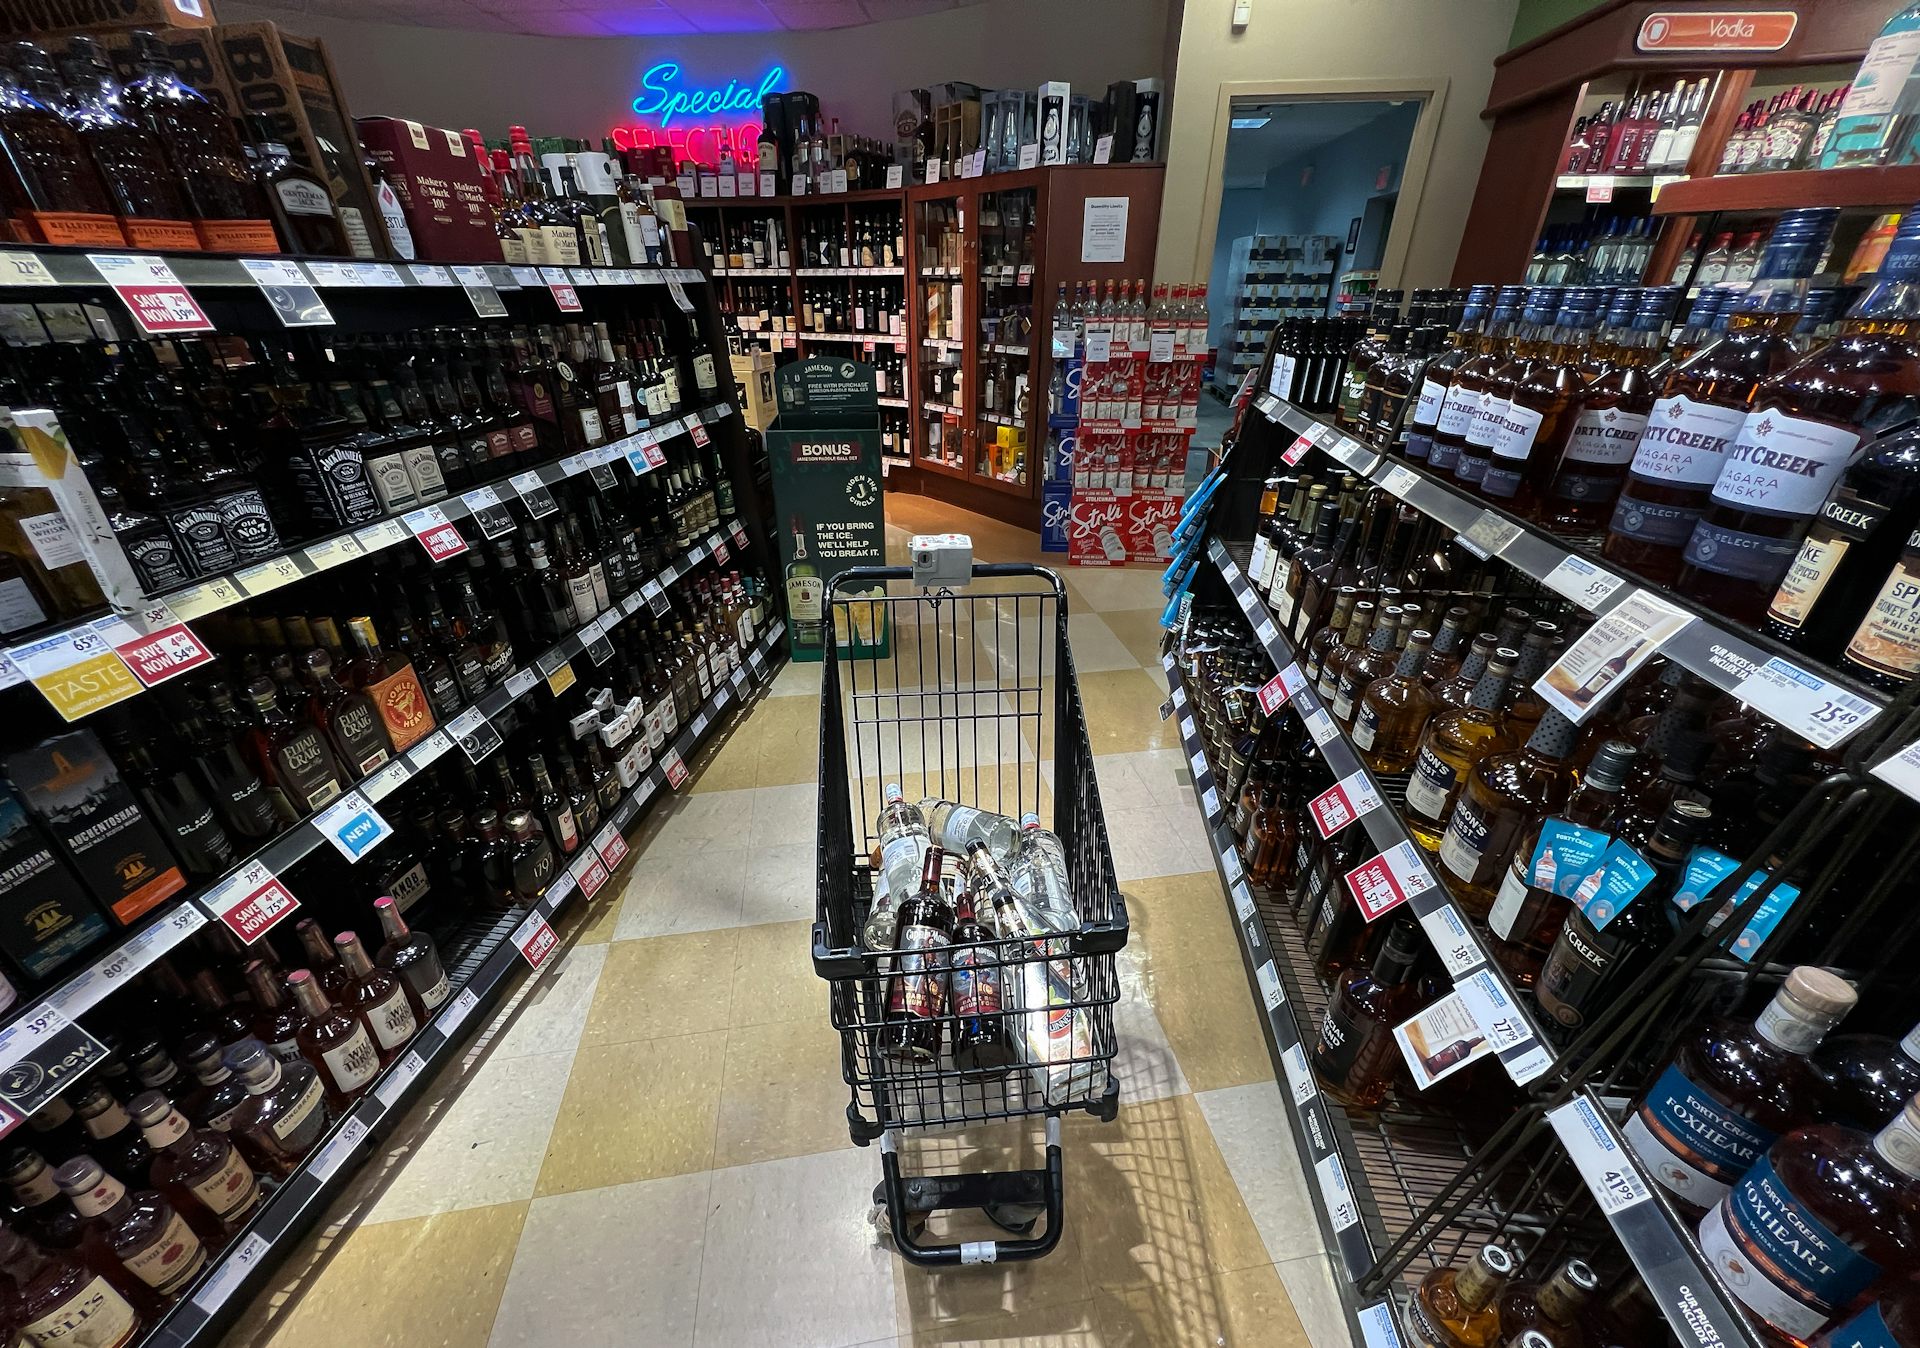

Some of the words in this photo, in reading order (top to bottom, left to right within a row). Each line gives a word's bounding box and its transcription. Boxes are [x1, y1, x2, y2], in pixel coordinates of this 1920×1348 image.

[1710, 18, 1755, 38] Vodka
[632, 63, 782, 128] Special
[416, 175, 449, 188] Maker's
[453, 181, 483, 193] Maker's
[282, 188, 325, 199] GENTLEMAN
[429, 187, 451, 199] Mark
[464, 191, 485, 203] Mark
[432, 198, 446, 210] 101
[468, 203, 480, 213] 101
[561, 239, 578, 248] Mark
[133, 293, 164, 307] SAVE
[140, 309, 174, 323] NOW
[803, 364, 834, 374] JAMESON
[1574, 426, 1605, 438] ORTY
[1605, 427, 1639, 442] CREEK
[1666, 427, 1731, 454] CREEK
[801, 443, 852, 456] BONUS
[319, 453, 338, 472] JACK
[1635, 458, 1686, 475] WHISKY
[1750, 446, 1828, 478] CREEK
[845, 474, 865, 494] WIDEN
[866, 476, 878, 493] THE
[343, 489, 370, 501] WHISKEY
[849, 495, 876, 507] CIRCLE
[222, 510, 239, 526] JACK
[1071, 501, 1123, 539] Stoli
[1128, 500, 1178, 535] Stoli
[1639, 505, 1681, 519] SELECT
[1826, 502, 1875, 530] CREEK
[29, 516, 64, 531] SUNTO
[175, 515, 195, 533] JACK
[237, 522, 269, 539] No.7
[494, 515, 511, 528] new
[816, 523, 825, 531] IF
[825, 522, 845, 531] YOU
[846, 521, 875, 530] BRING
[425, 534, 442, 547] SAVE
[816, 532, 835, 540] THE
[817, 541, 846, 549] WE'LL
[845, 540, 870, 548] HELP
[1713, 533, 1760, 550] SELECT
[431, 543, 449, 555] NOW
[818, 550, 838, 558] YOU
[838, 549, 869, 557] BREAK
[870, 548, 880, 557] IT.
[787, 580, 821, 590] JAMESON
[1881, 616, 1919, 634] WHISK
[132, 642, 164, 662] SAVE
[1709, 644, 1727, 660] OUR
[1725, 652, 1750, 672] PRICES
[1747, 663, 1760, 675] DO
[140, 655, 173, 675] NOW
[1708, 654, 1739, 676] INCLUDE
[45, 662, 129, 702] TASTE
[1769, 659, 1799, 680] CANADIAN
[1796, 672, 1825, 691] WHISKY
[386, 680, 417, 707] HOWLER
[338, 704, 368, 728] ELIJAH
[402, 711, 424, 729] HEAD
[342, 716, 372, 739] CRAIG
[284, 733, 316, 758] ELIJAH
[288, 747, 321, 771] CRAIG
[1317, 799, 1330, 815] NOW
[1328, 791, 1342, 809] SAVE
[67, 804, 140, 849] AUCHENTOSHAN
[345, 819, 373, 844] NEW
[1555, 833, 1576, 843] FORTY
[1574, 838, 1594, 849] CREEK
[0, 849, 52, 886] ENTOSHAN
[1368, 865, 1386, 886] SAVE
[391, 871, 420, 900] KNOB
[1354, 872, 1373, 893] NOW
[235, 902, 260, 924] SAVE
[241, 912, 268, 934] NOW
[527, 941, 541, 955] SAVE
[531, 949, 545, 963] NOW
[1567, 929, 1608, 967] CREEK
[47, 1040, 93, 1079] new
[277, 1079, 320, 1128] LONGBRANCH
[1577, 1097, 1601, 1132] CANADIAN
[1597, 1128, 1616, 1152] WHISKY
[1685, 1094, 1722, 1124] FORTY
[1721, 1119, 1762, 1146] CREEK
[1760, 1177, 1795, 1213] FORTY
[1786, 1209, 1832, 1252] CREEK
[1748, 1219, 1778, 1253] WHISKY
[1679, 1284, 1698, 1310] OUR
[1693, 1305, 1720, 1340] PRICES
[1677, 1300, 1711, 1345] INCLUDE
